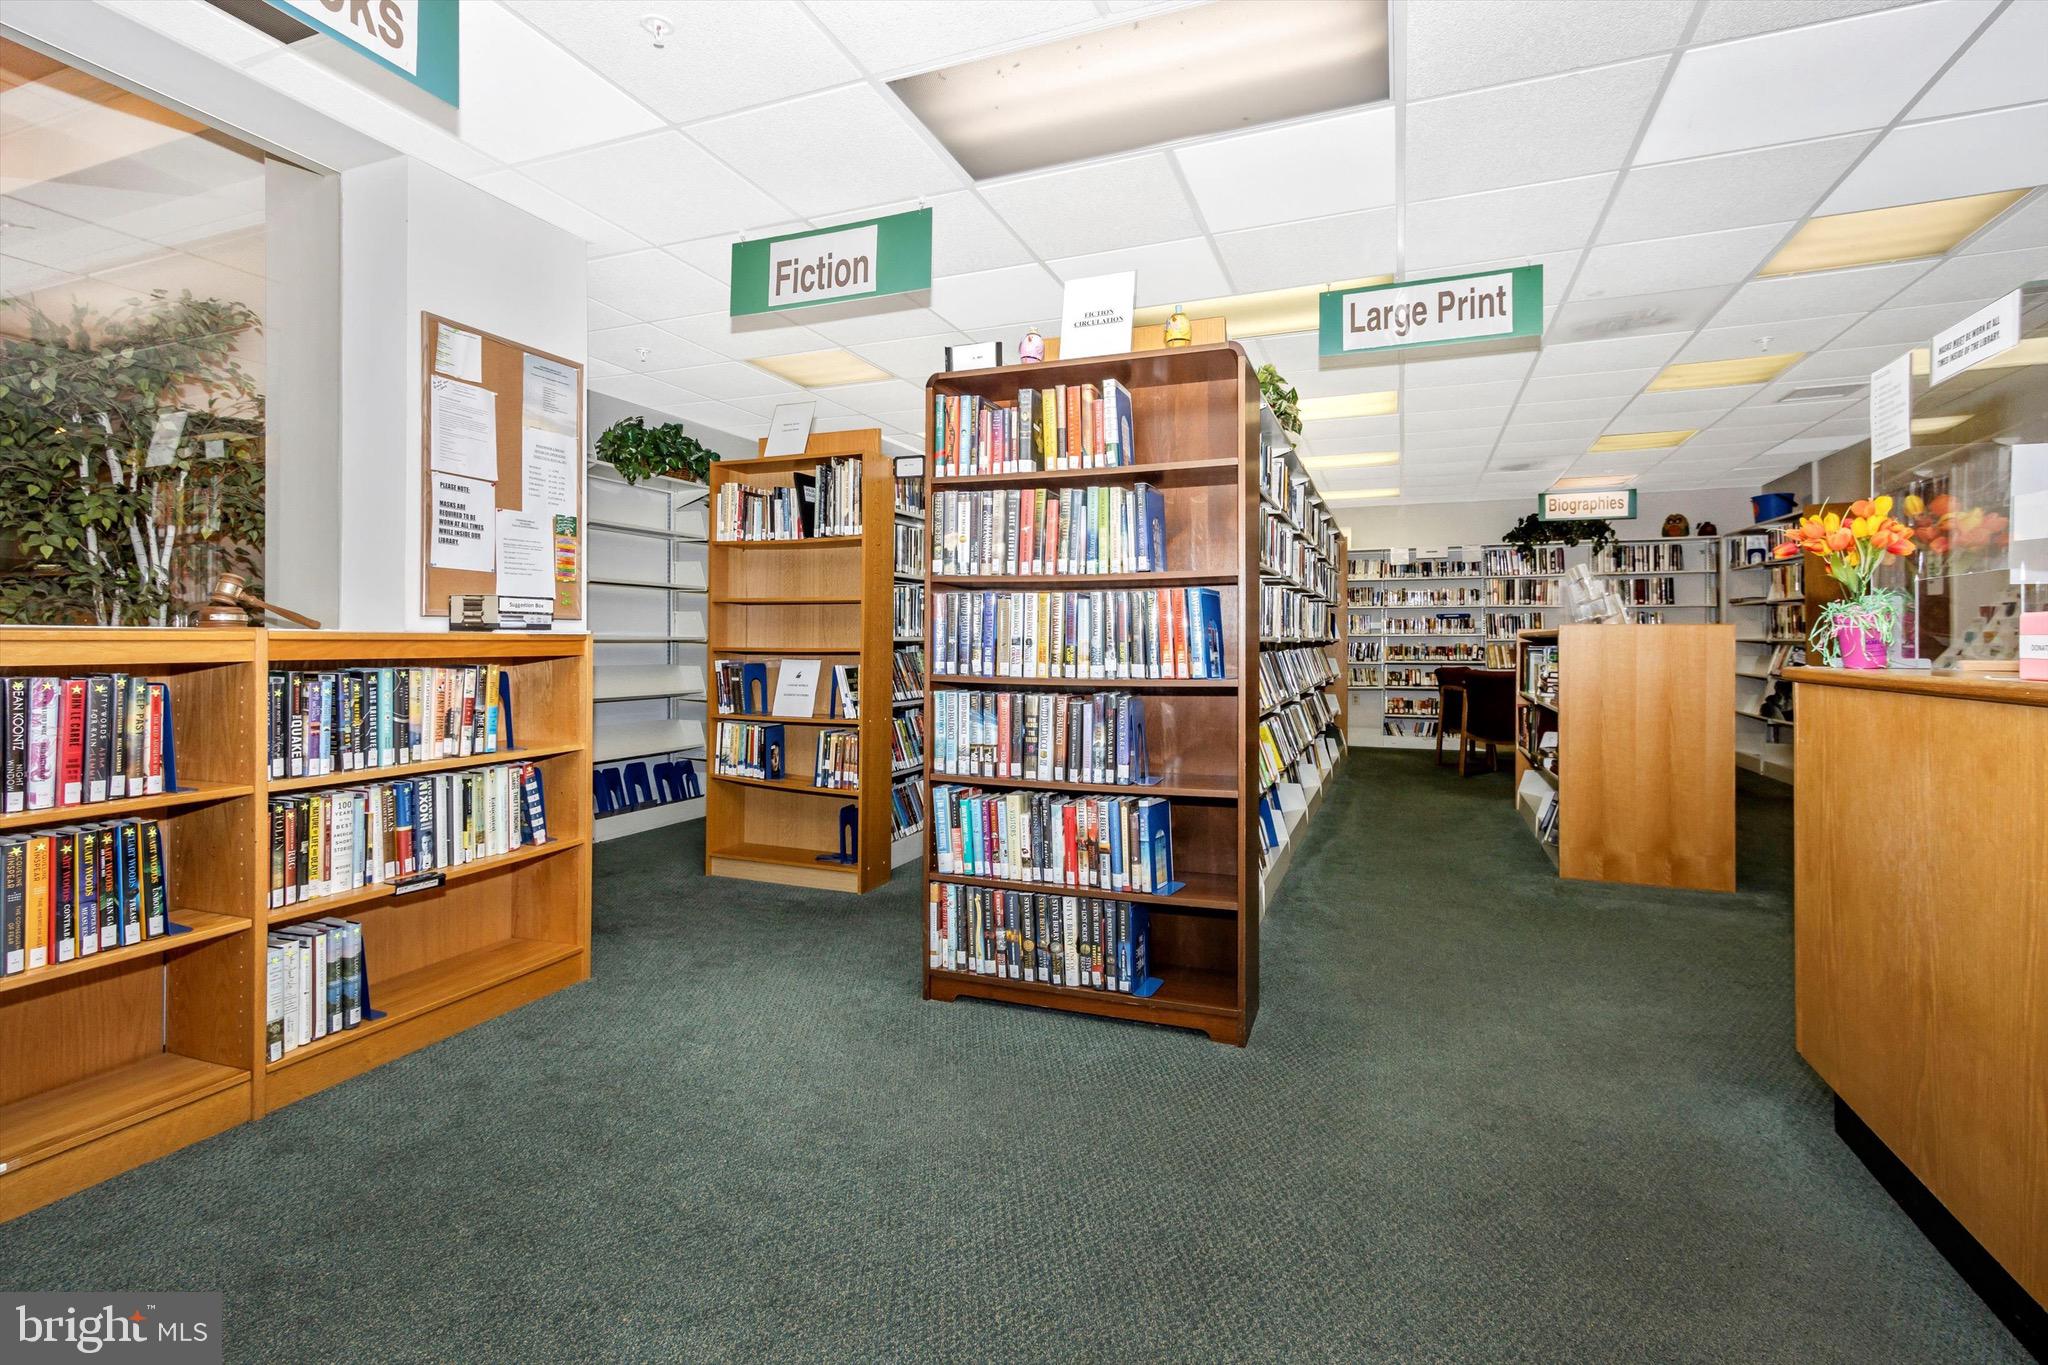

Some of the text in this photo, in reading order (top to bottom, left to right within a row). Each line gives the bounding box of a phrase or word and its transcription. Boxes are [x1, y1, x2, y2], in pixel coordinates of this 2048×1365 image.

[775, 252, 869, 297] Fiction
[1073, 316, 1124, 328] CIRCULATION
[1084, 309, 1114, 319] FICTION
[1350, 285, 1507, 337] Large Print
[1971, 325, 1985, 338] WORN
[1992, 315, 2000, 327] ALL
[1950, 348, 1964, 362] INSIDE
[1964, 346, 1970, 355] OF
[1970, 340, 1979, 351] THE
[440, 481, 456, 491] PLEASE
[439, 500, 456, 509] MASKS
[439, 509, 463, 519] REQUIRED
[1548, 496, 1624, 516] Biographies
[438, 527, 481, 540] WHILE INSIDE OUR
[439, 518, 453, 527] WORN
[469, 523, 484, 531] TIMES
[509, 601, 534, 609] Suggestion
[71, 692, 81, 709] OHN
[136, 694, 144, 710] EEP
[70, 712, 80, 721] LE
[136, 713, 144, 736] PAST
[477, 713, 485, 726] THE
[1041, 698, 1049, 749] DAVID BALDACCI
[1056, 698, 1065, 745] DAVID BALDACCI
[12, 713, 24, 750] KOONTZ
[291, 720, 302, 759] QUAKE
[6, 760, 14, 792] WINDOW
[15, 764, 23, 786] NIGHT
[338, 801, 352, 810] 100
[419, 782, 428, 823] NIXON
[311, 807, 319, 829] NATURE
[275, 813, 284, 851] TOLEN
[62, 839, 72, 870] SART
[288, 850, 296, 870] RBG
[85, 840, 94, 896] TUART WOODS
[128, 859, 137, 888] WOODS
[150, 855, 159, 883] WOODS
[310, 856, 318, 876] DEATH
[63, 872, 72, 902] WOODS
[106, 897, 114, 914] SKIN
[1052, 920, 1060, 942] BERRY
[1065, 900, 1074, 946] STEVE BERRY
